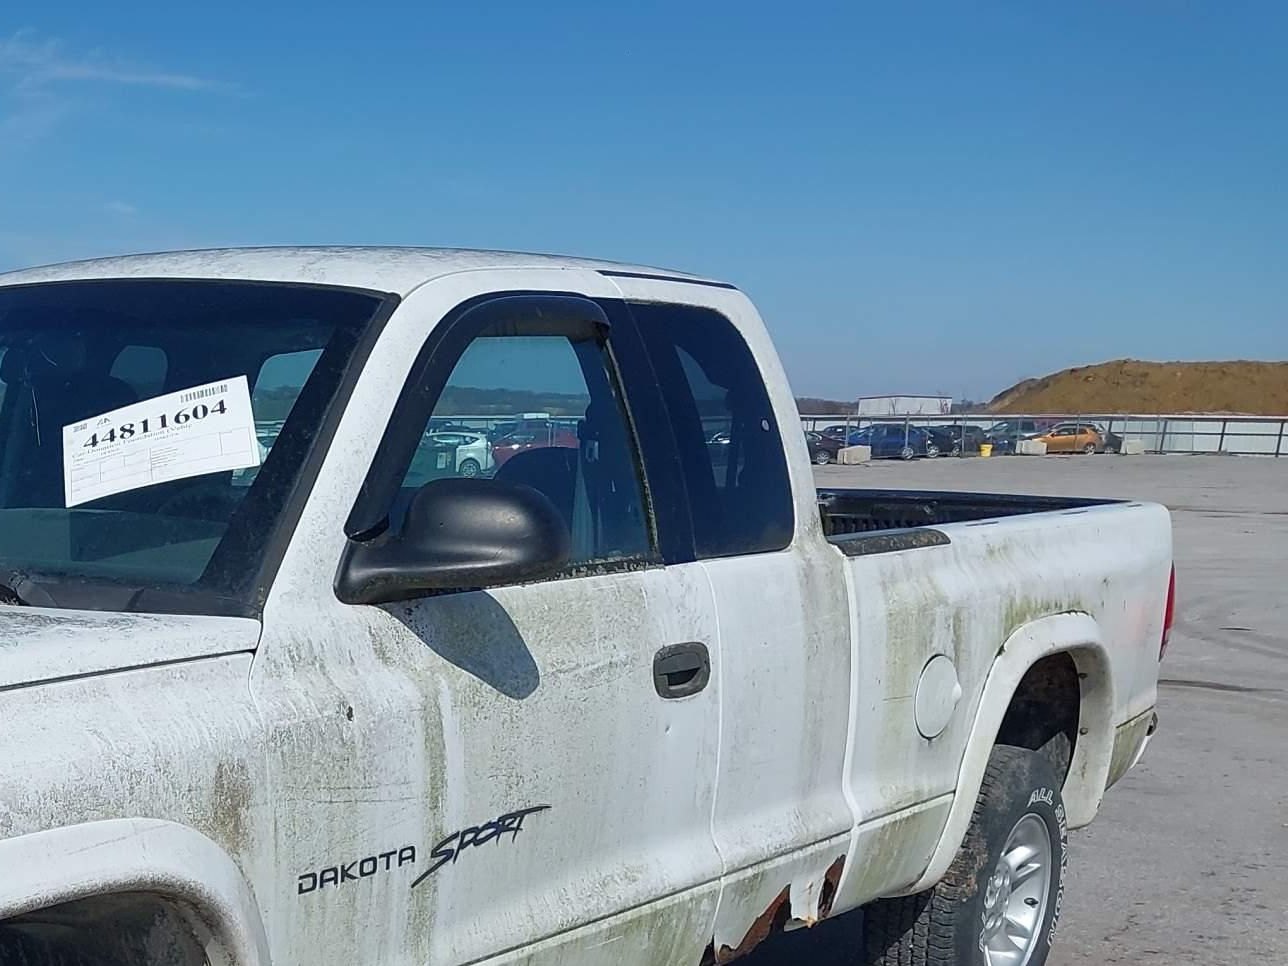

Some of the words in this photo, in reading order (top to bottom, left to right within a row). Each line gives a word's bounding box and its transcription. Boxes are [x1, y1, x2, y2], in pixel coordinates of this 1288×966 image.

[83, 399, 228, 449] 44811604
[298, 845, 416, 894] DAKOTA
[411, 804, 552, 889] SPORT
